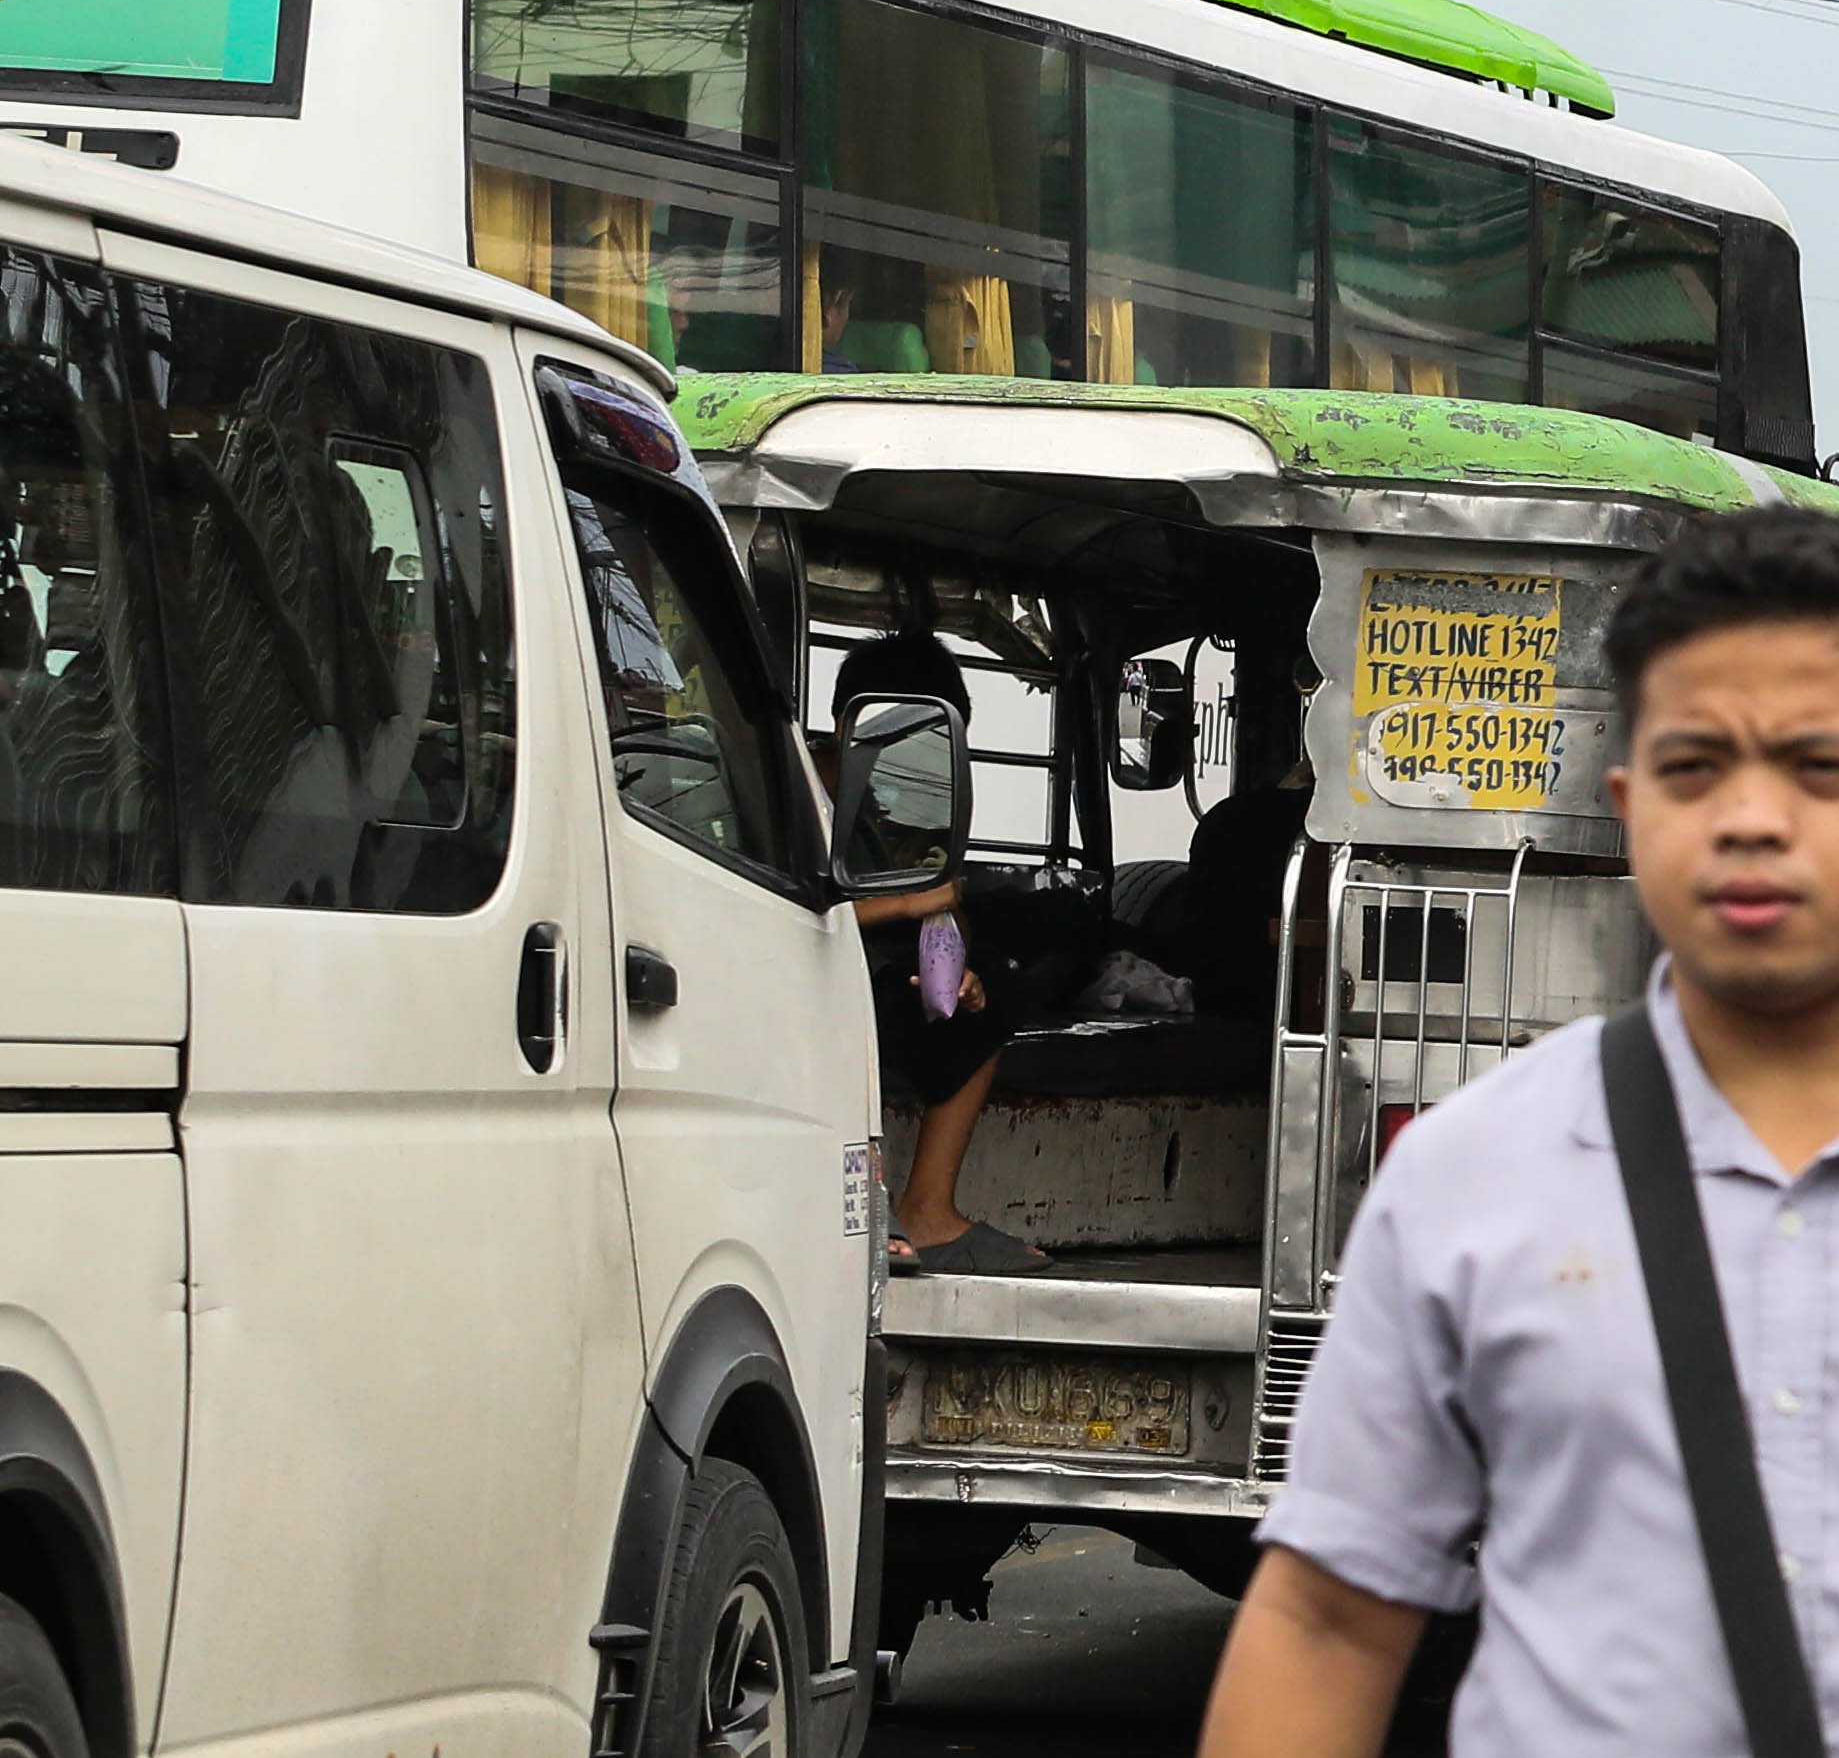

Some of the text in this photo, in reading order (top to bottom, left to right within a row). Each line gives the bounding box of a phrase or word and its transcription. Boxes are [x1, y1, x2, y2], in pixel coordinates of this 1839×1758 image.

[1367, 618, 1558, 662] HOTLINE 1342
[1366, 660, 1544, 704] TEXT/VIBER
